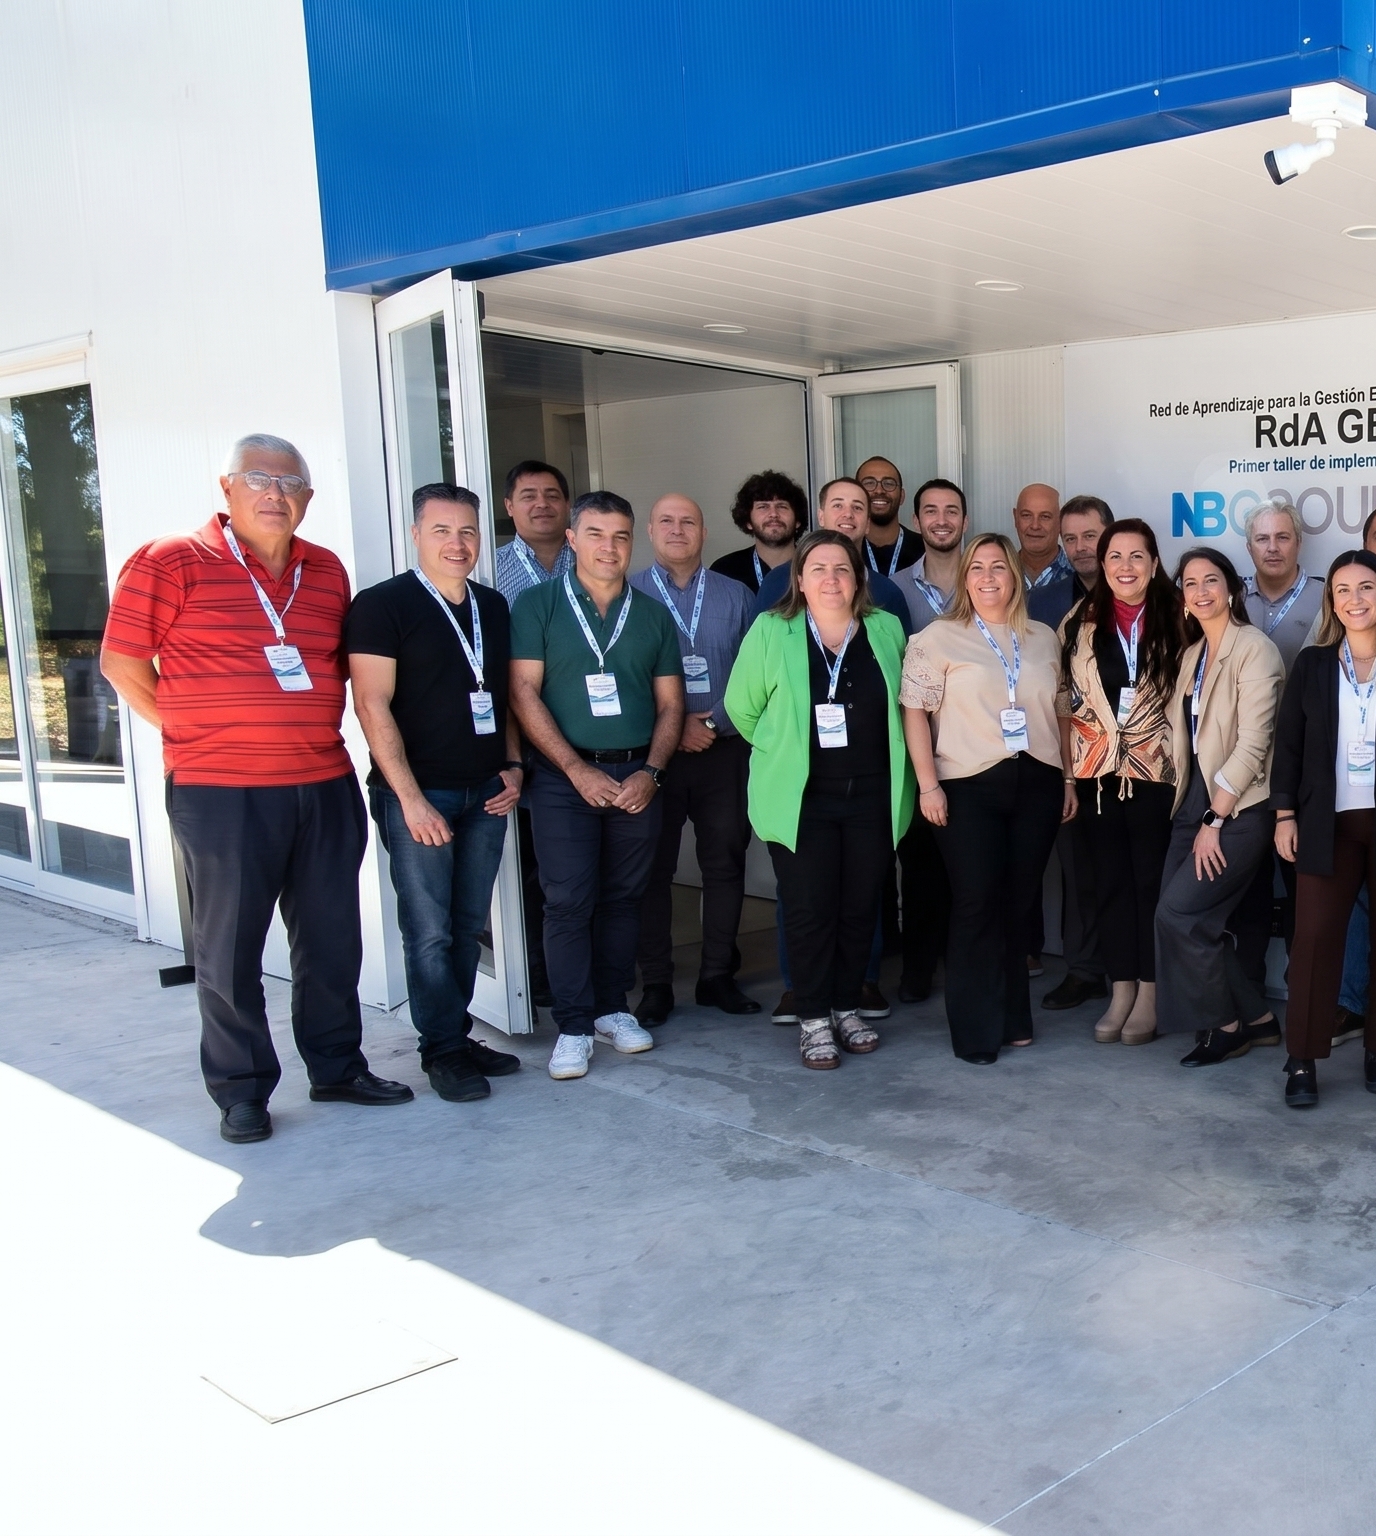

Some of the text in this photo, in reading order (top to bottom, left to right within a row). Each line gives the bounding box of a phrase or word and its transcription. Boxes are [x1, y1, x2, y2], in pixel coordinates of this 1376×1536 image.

[1150, 402, 1172, 417] Red
[1175, 401, 1189, 416] de
[1192, 396, 1264, 418] Aprendizaje
[1268, 396, 1295, 412] para
[1300, 392, 1310, 406] la
[1314, 387, 1365, 406] Gestión
[1255, 411, 1327, 448] RdA
[1229, 458, 1270, 473] Primer
[1273, 456, 1306, 472] taller
[1309, 455, 1326, 470] de
